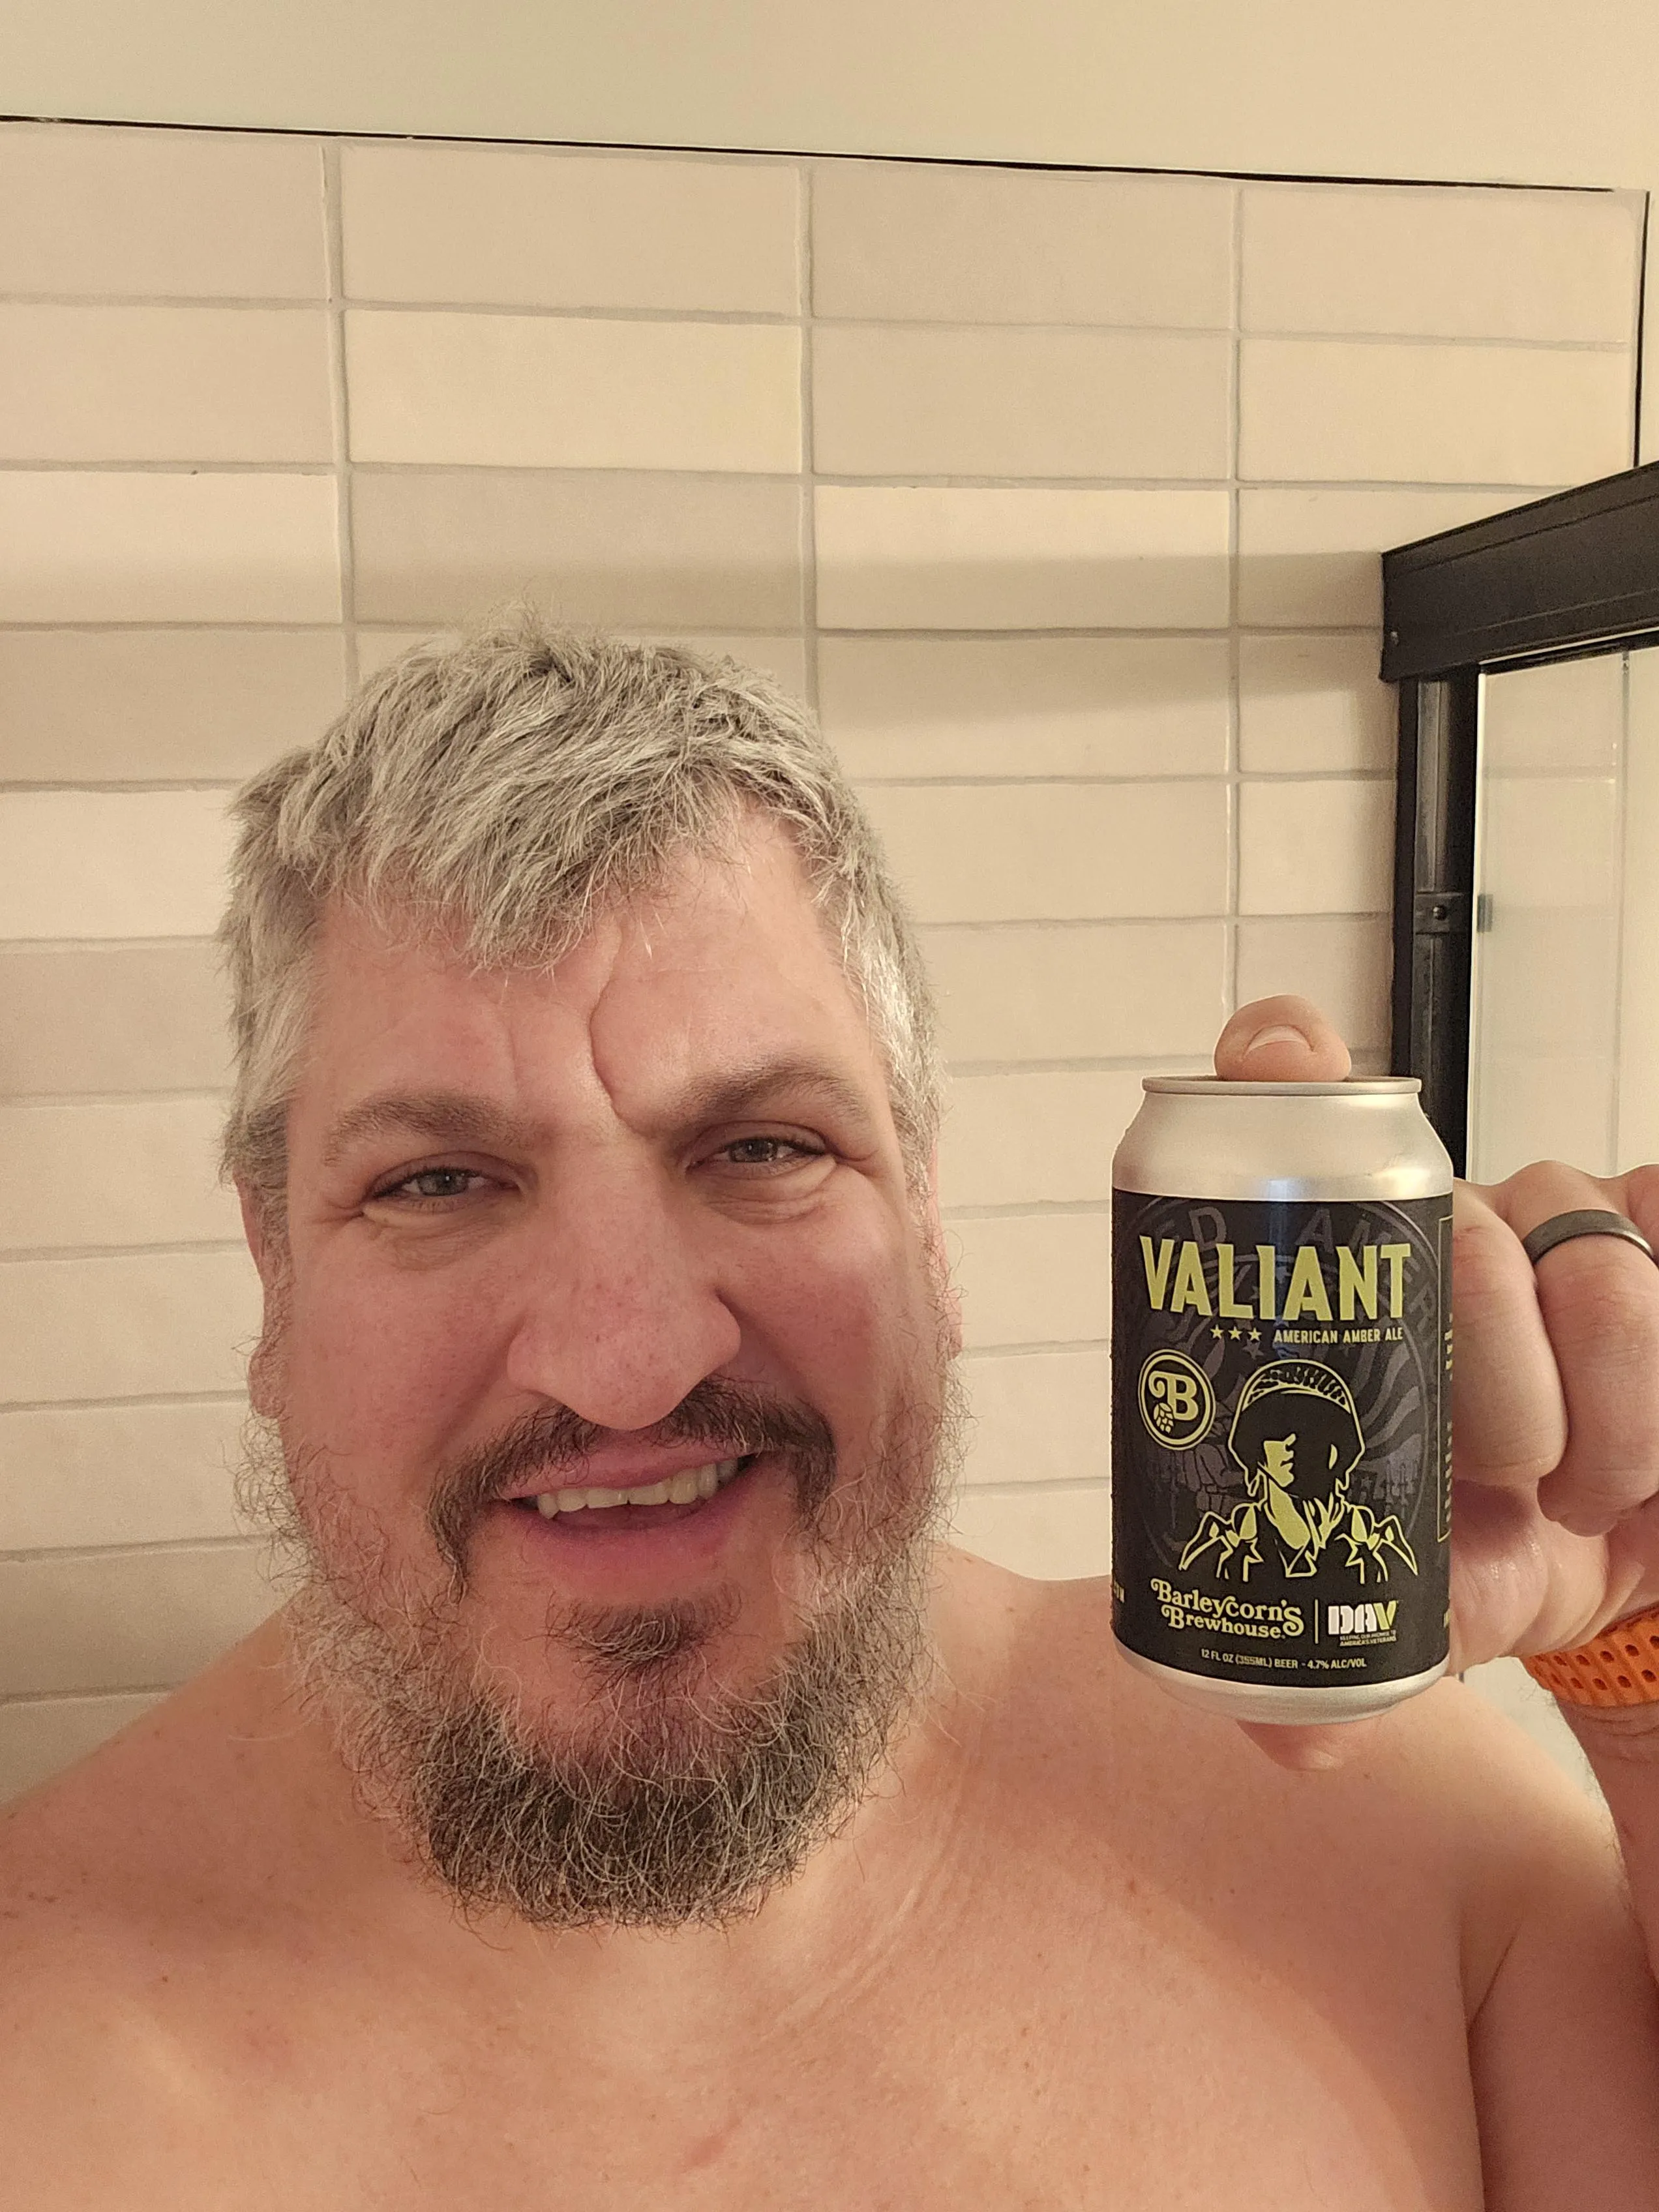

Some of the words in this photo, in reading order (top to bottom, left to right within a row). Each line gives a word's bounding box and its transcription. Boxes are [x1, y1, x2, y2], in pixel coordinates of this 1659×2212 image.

[1139, 1235, 1411, 1321] VALIANT
[1274, 1329, 1338, 1344] AMERICAN
[1343, 1328, 1381, 1343] AMBER
[1385, 1327, 1403, 1341] ALE
[1148, 1370, 1199, 1421] B
[1328, 1600, 1396, 1634] DAV
[1201, 1648, 1210, 1658] 12
[1211, 1651, 1221, 1661] FL
[1222, 1652, 1234, 1664] OZ
[1274, 1658, 1298, 1669] BEER
[1307, 1659, 1330, 1669] 4.7%
[1330, 1658, 1368, 1669] ALC/VOL
